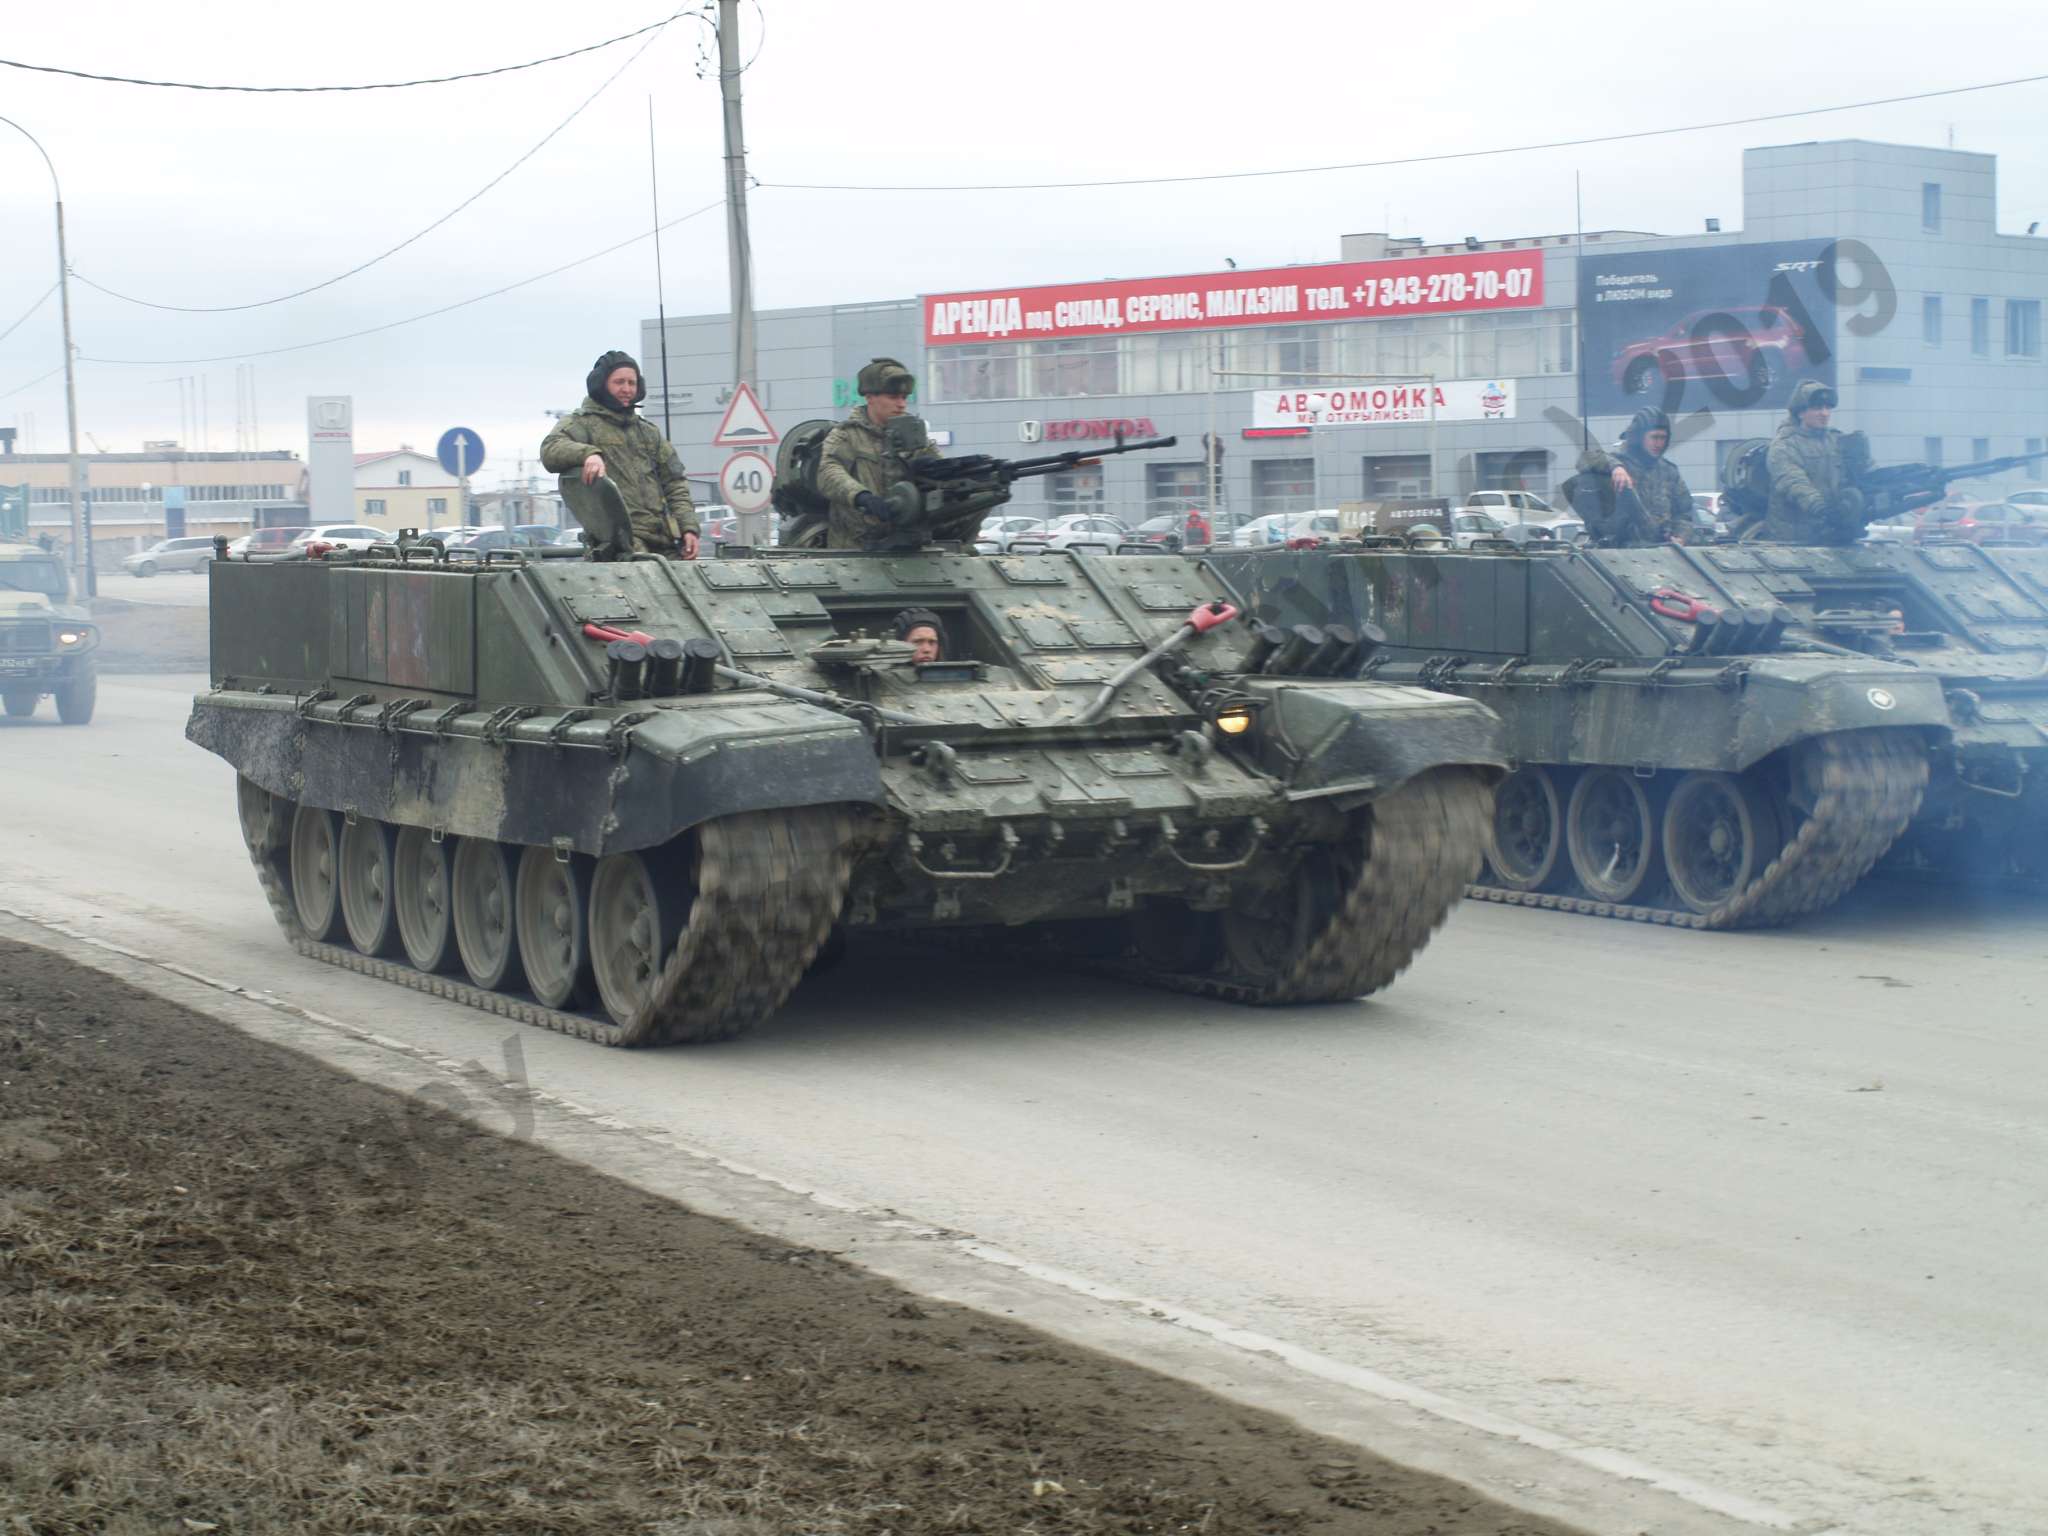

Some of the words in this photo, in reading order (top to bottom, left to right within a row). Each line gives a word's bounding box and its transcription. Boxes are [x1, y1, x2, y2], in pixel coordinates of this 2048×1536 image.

[1773, 260, 1824, 272] SRT
[932, 297, 1022, 337] АРЕНДА
[1025, 311, 1054, 331] под
[1055, 298, 1124, 328] СКЛАД,
[1126, 292, 1203, 321] СЕРВИС,
[1206, 285, 1298, 317] МАГАЗИН
[1305, 287, 1349, 311] тел.
[1044, 417, 1158, 440] HONDA
[733, 470, 763, 494] 40
